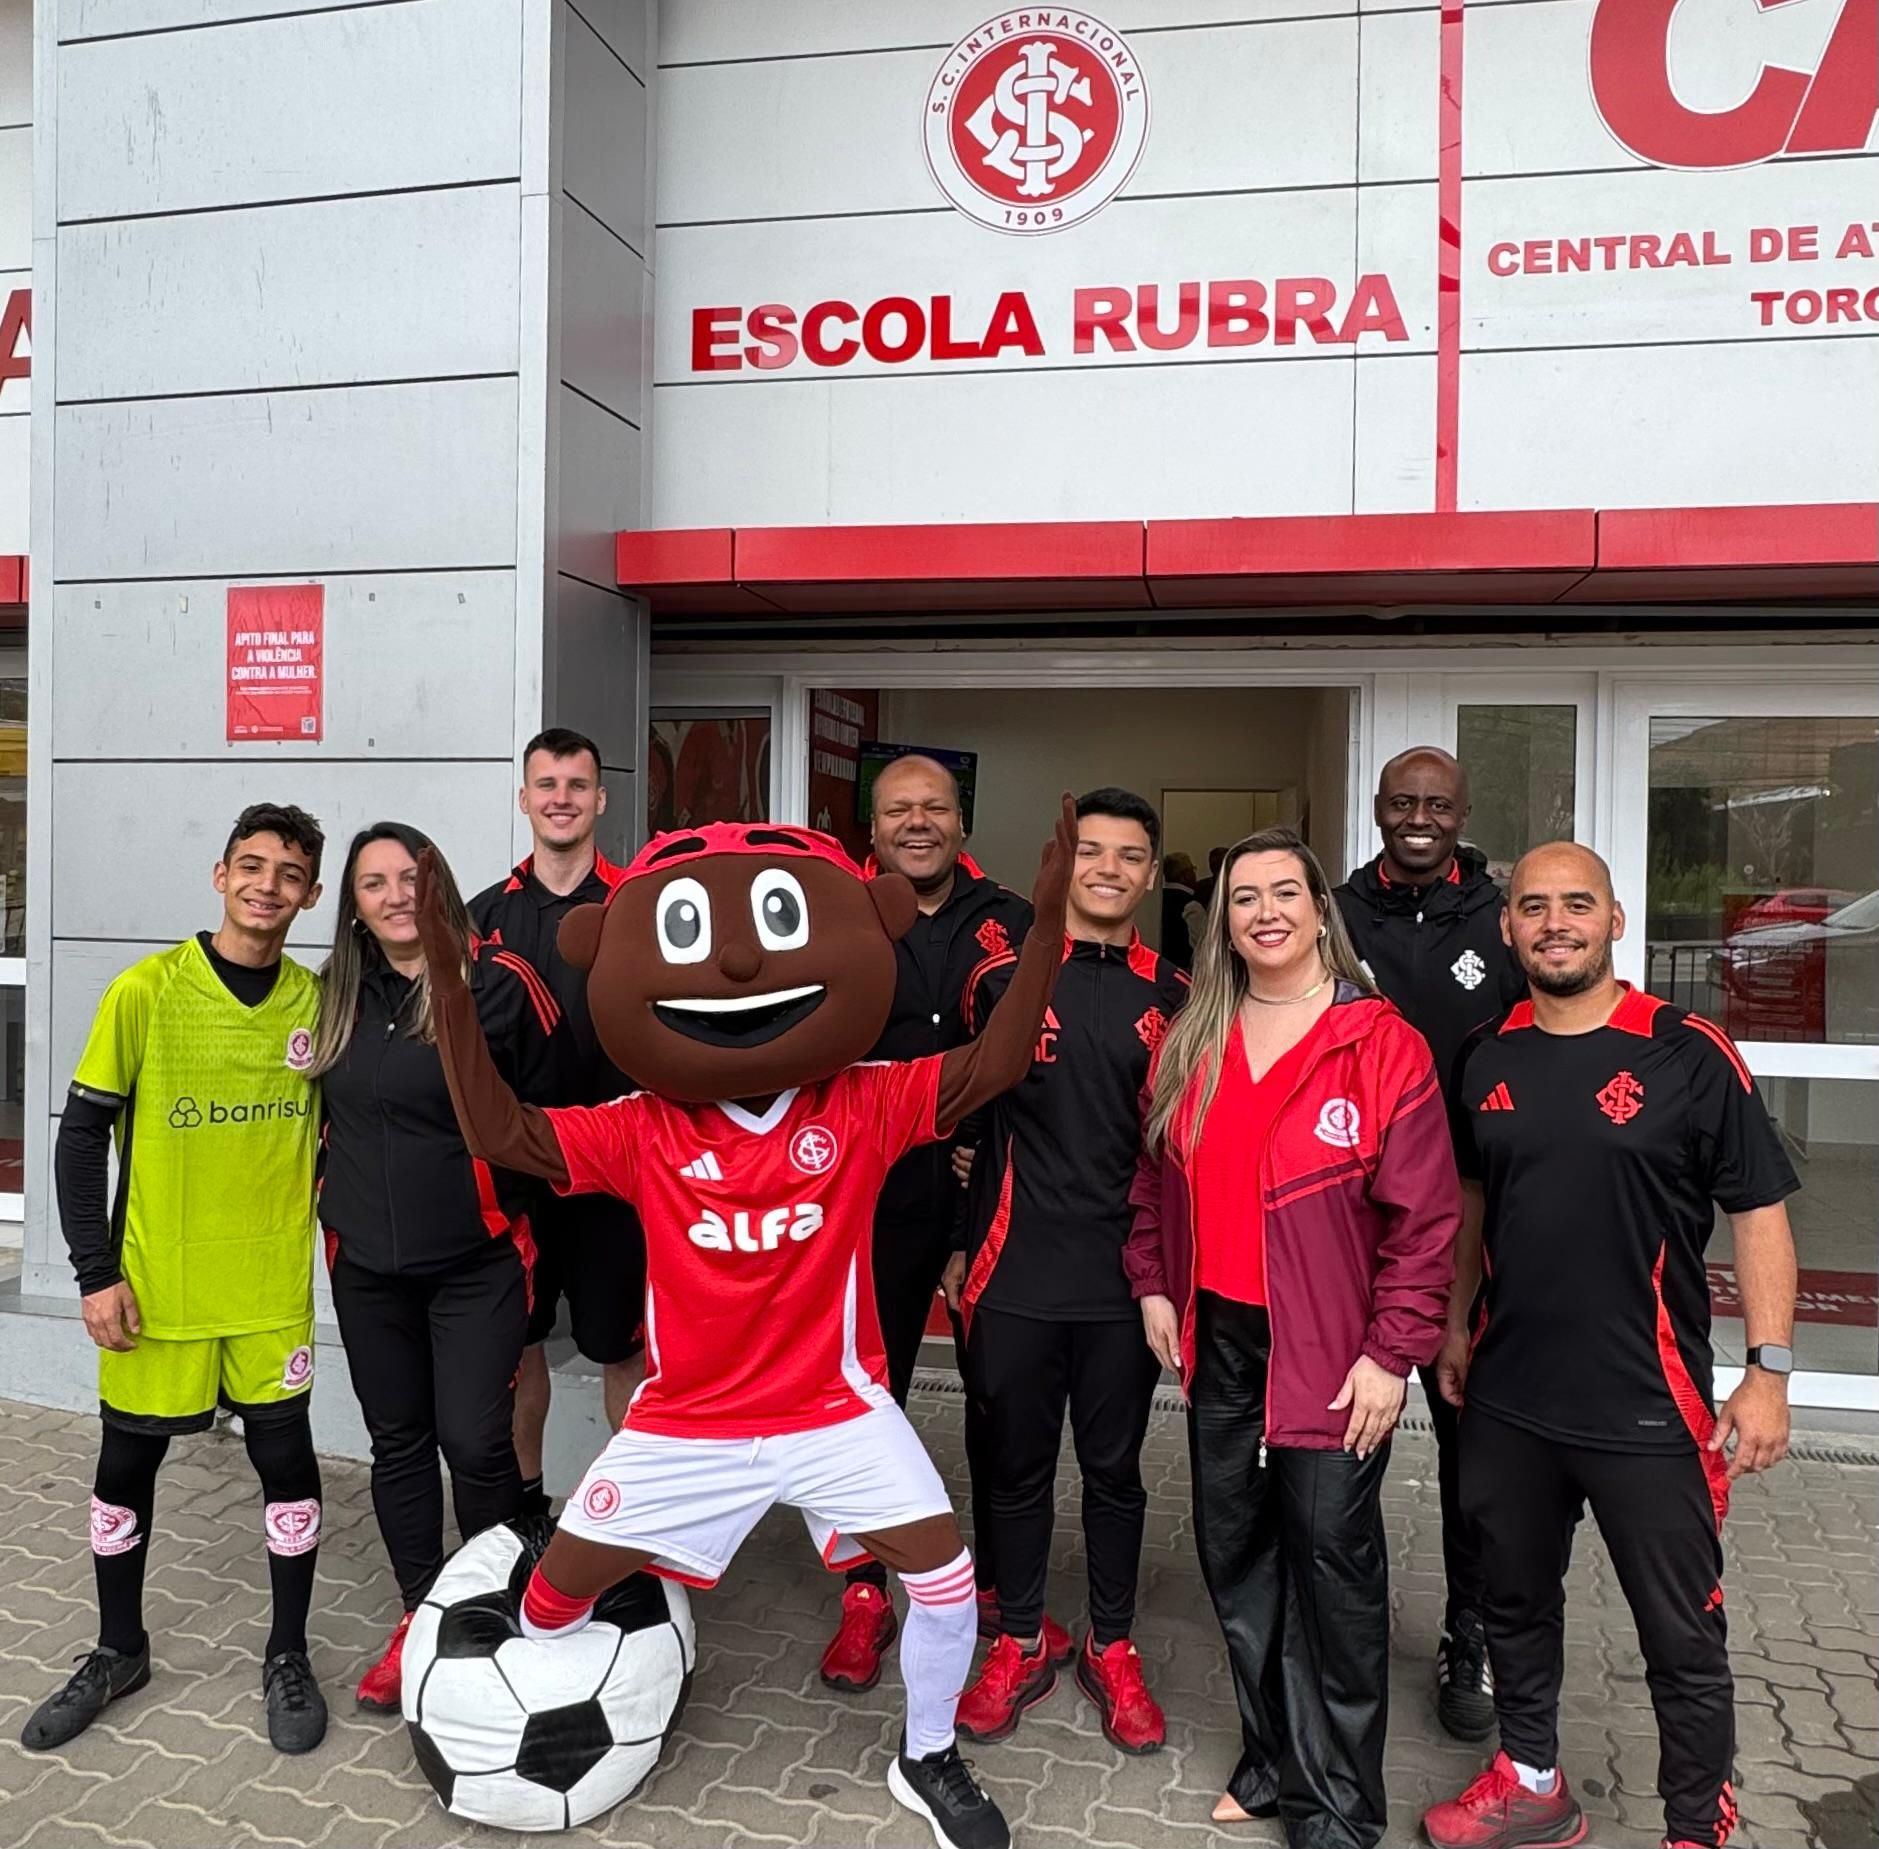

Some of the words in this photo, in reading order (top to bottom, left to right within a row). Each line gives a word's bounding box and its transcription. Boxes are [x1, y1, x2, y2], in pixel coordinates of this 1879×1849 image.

[957, 12, 1140, 102] INTERNACIONAL
[1004, 207, 1064, 226] 1909
[1487, 231, 1732, 276] CENTRAL
[1750, 225, 1819, 263] DE
[1835, 221, 1879, 259] A
[691, 291, 1045, 372] ESCOLA
[1073, 274, 1408, 353] RUBRA
[234, 632, 262, 646] APITO
[263, 631, 289, 645] FINAL
[291, 630, 315, 645] PARA
[247, 650, 254, 663] A
[255, 646, 302, 663] VIOLÊNCIA
[231, 666, 268, 680] CONTRA
[268, 666, 277, 680] A
[209, 1093, 313, 1123] banrisul
